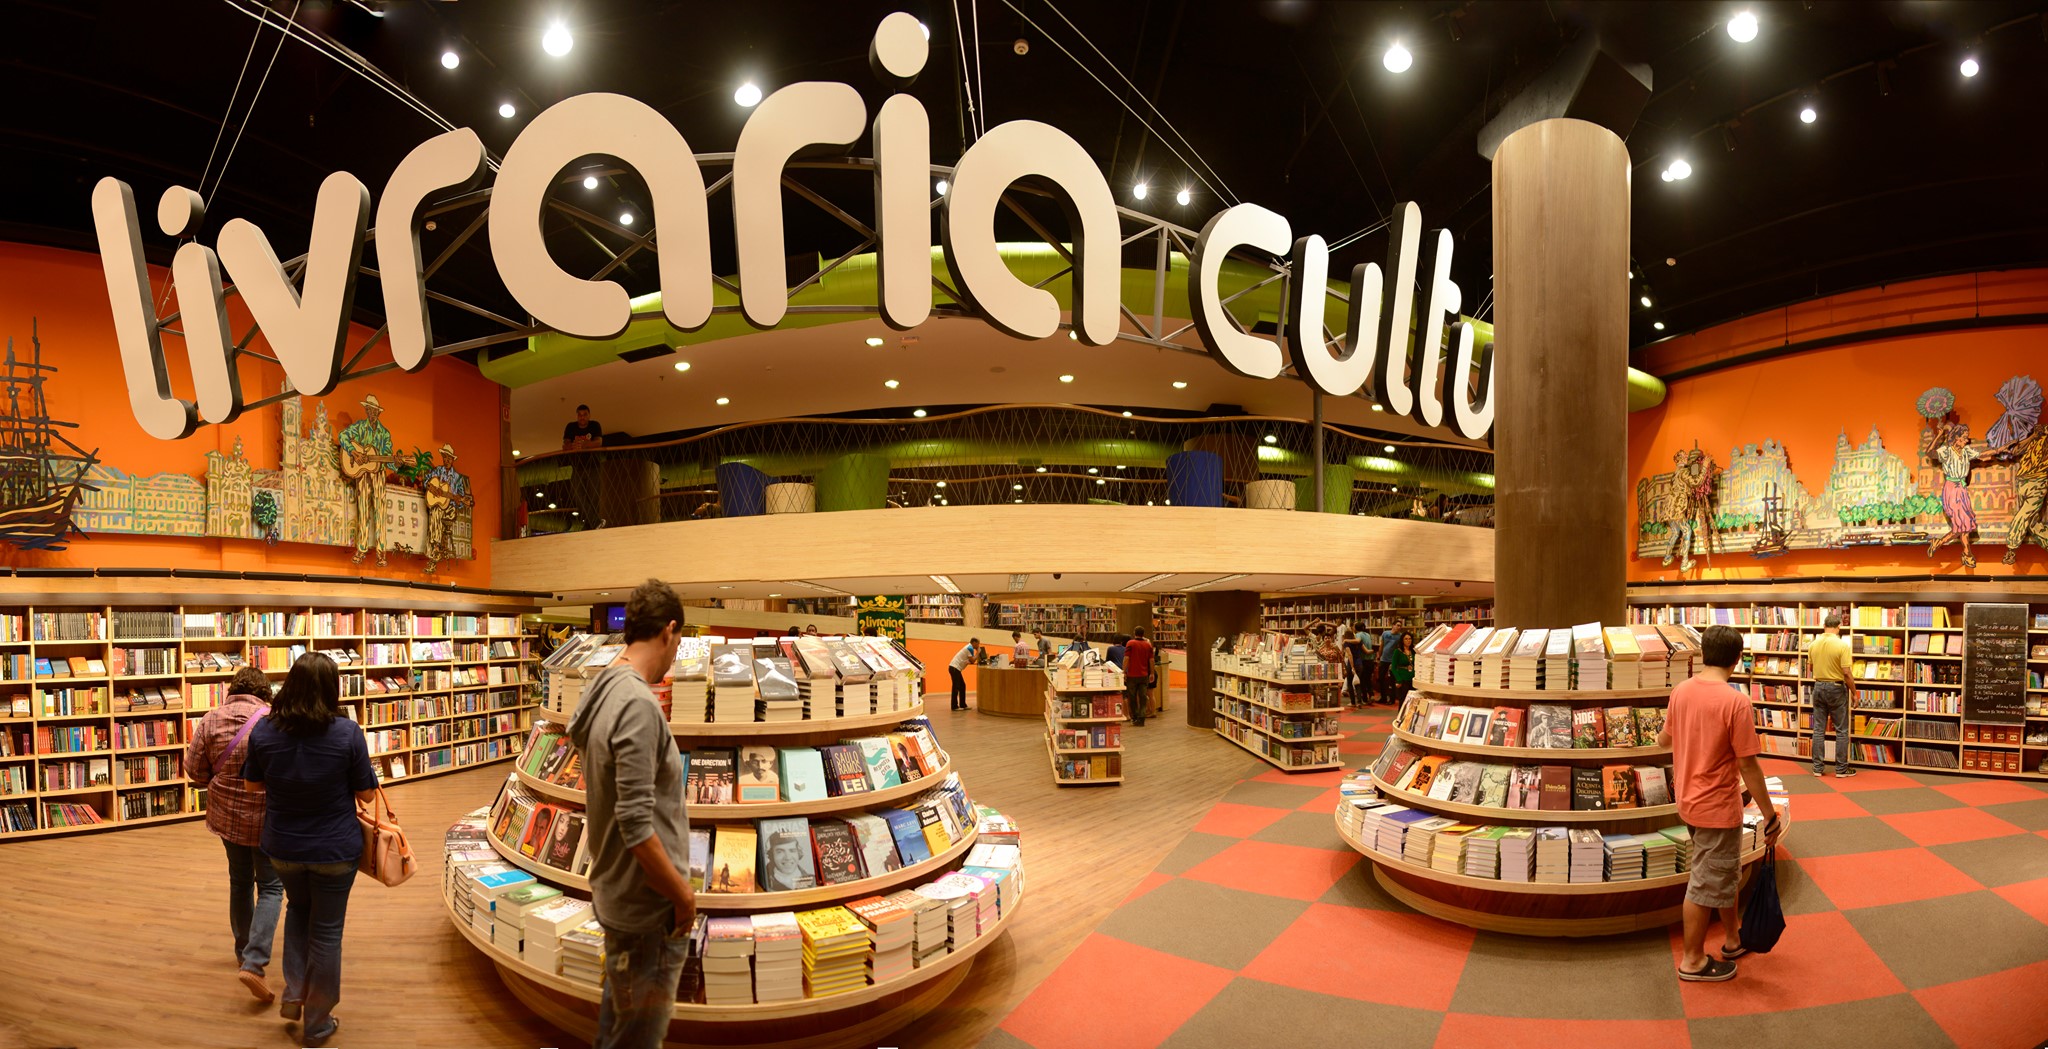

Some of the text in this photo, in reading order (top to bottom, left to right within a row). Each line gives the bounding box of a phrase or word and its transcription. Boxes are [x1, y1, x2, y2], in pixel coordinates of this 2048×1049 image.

[90, 11, 1495, 441] livraria cultu
[866, 616, 898, 628] Livraria
[1574, 711, 1597, 725] FIDEL
[691, 758, 727, 767] ONE DIRECTION
[834, 750, 859, 763] SAULO
[837, 760, 863, 775] RAMOS
[842, 777, 868, 793] LEI
[855, 899, 893, 914] PAULO
